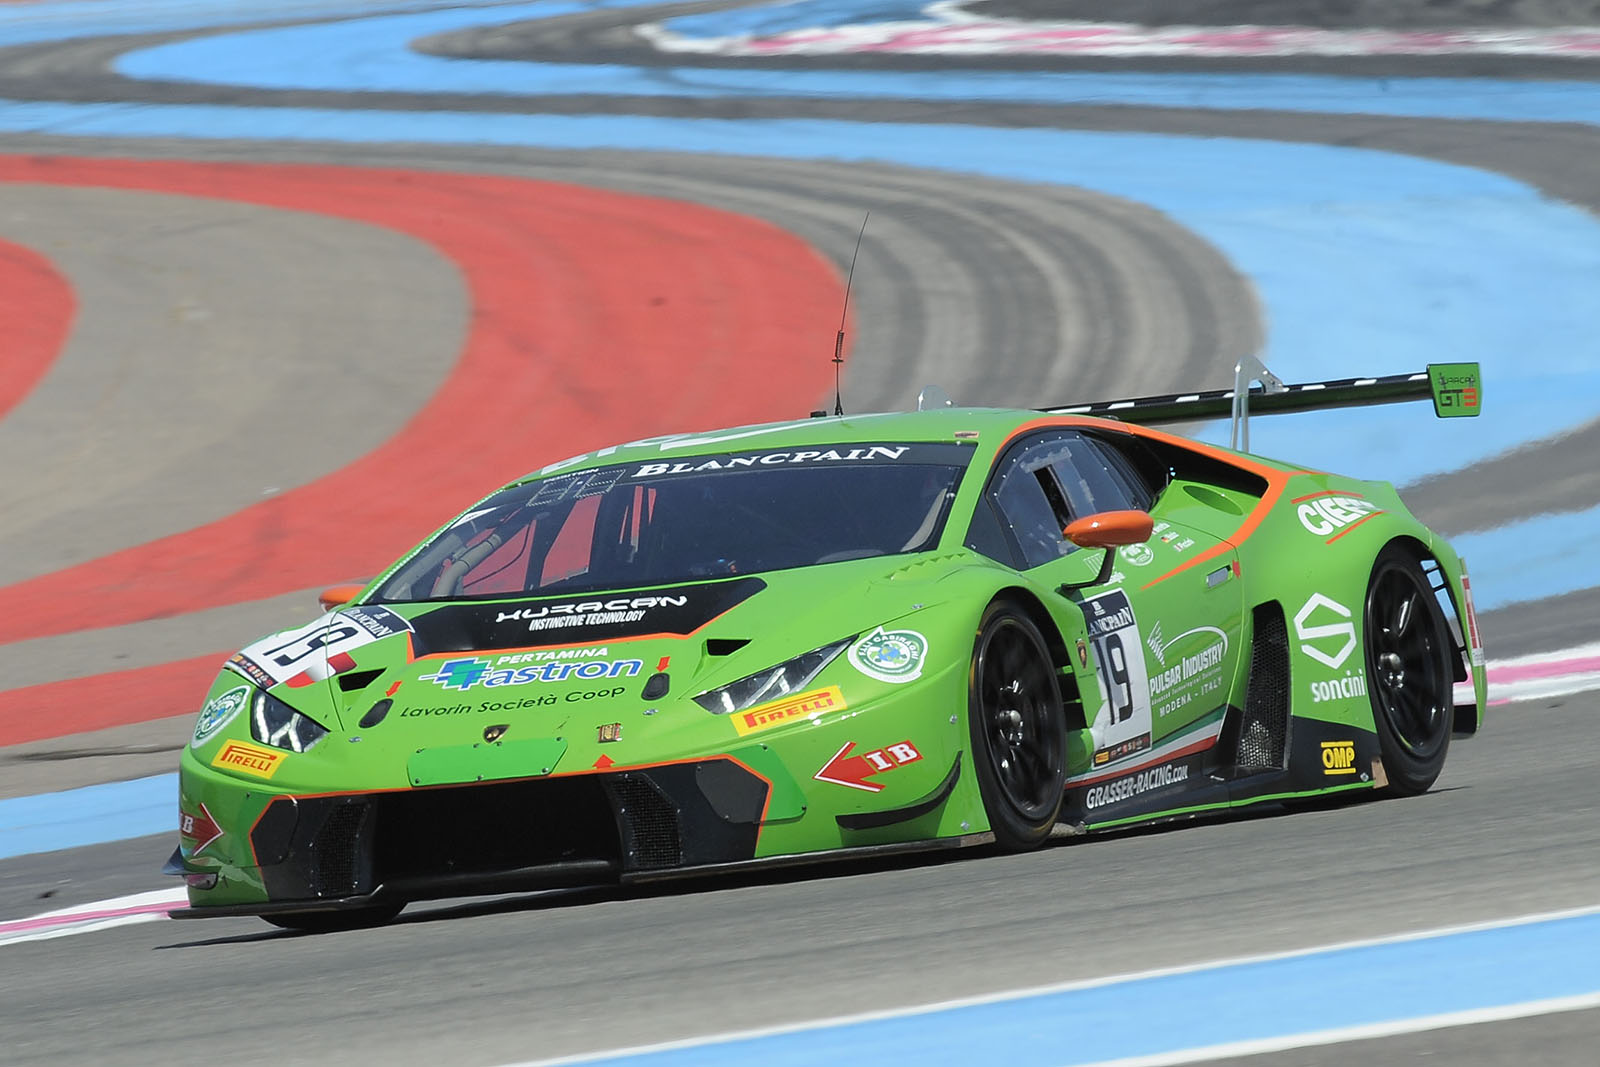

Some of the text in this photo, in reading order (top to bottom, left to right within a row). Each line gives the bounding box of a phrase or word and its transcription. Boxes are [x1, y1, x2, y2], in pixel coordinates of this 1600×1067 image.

[1439, 387, 1477, 407] GT3
[631, 446, 910, 478] BLANCPAIN
[528, 609, 646, 631] INSTINCTIVE TECHNOLOGY
[498, 647, 609, 665] PERTAMINA
[1092, 633, 1133, 726] 19
[1150, 664, 1182, 697] PULSAR
[1310, 668, 1367, 703] soncini
[400, 686, 626, 718] Lavorin Società Coop
[743, 691, 835, 729] PIRELLI
[1159, 693, 1193, 718] MODENA
[220, 744, 278, 772] PIRELLI
[1322, 747, 1356, 769] OMP
